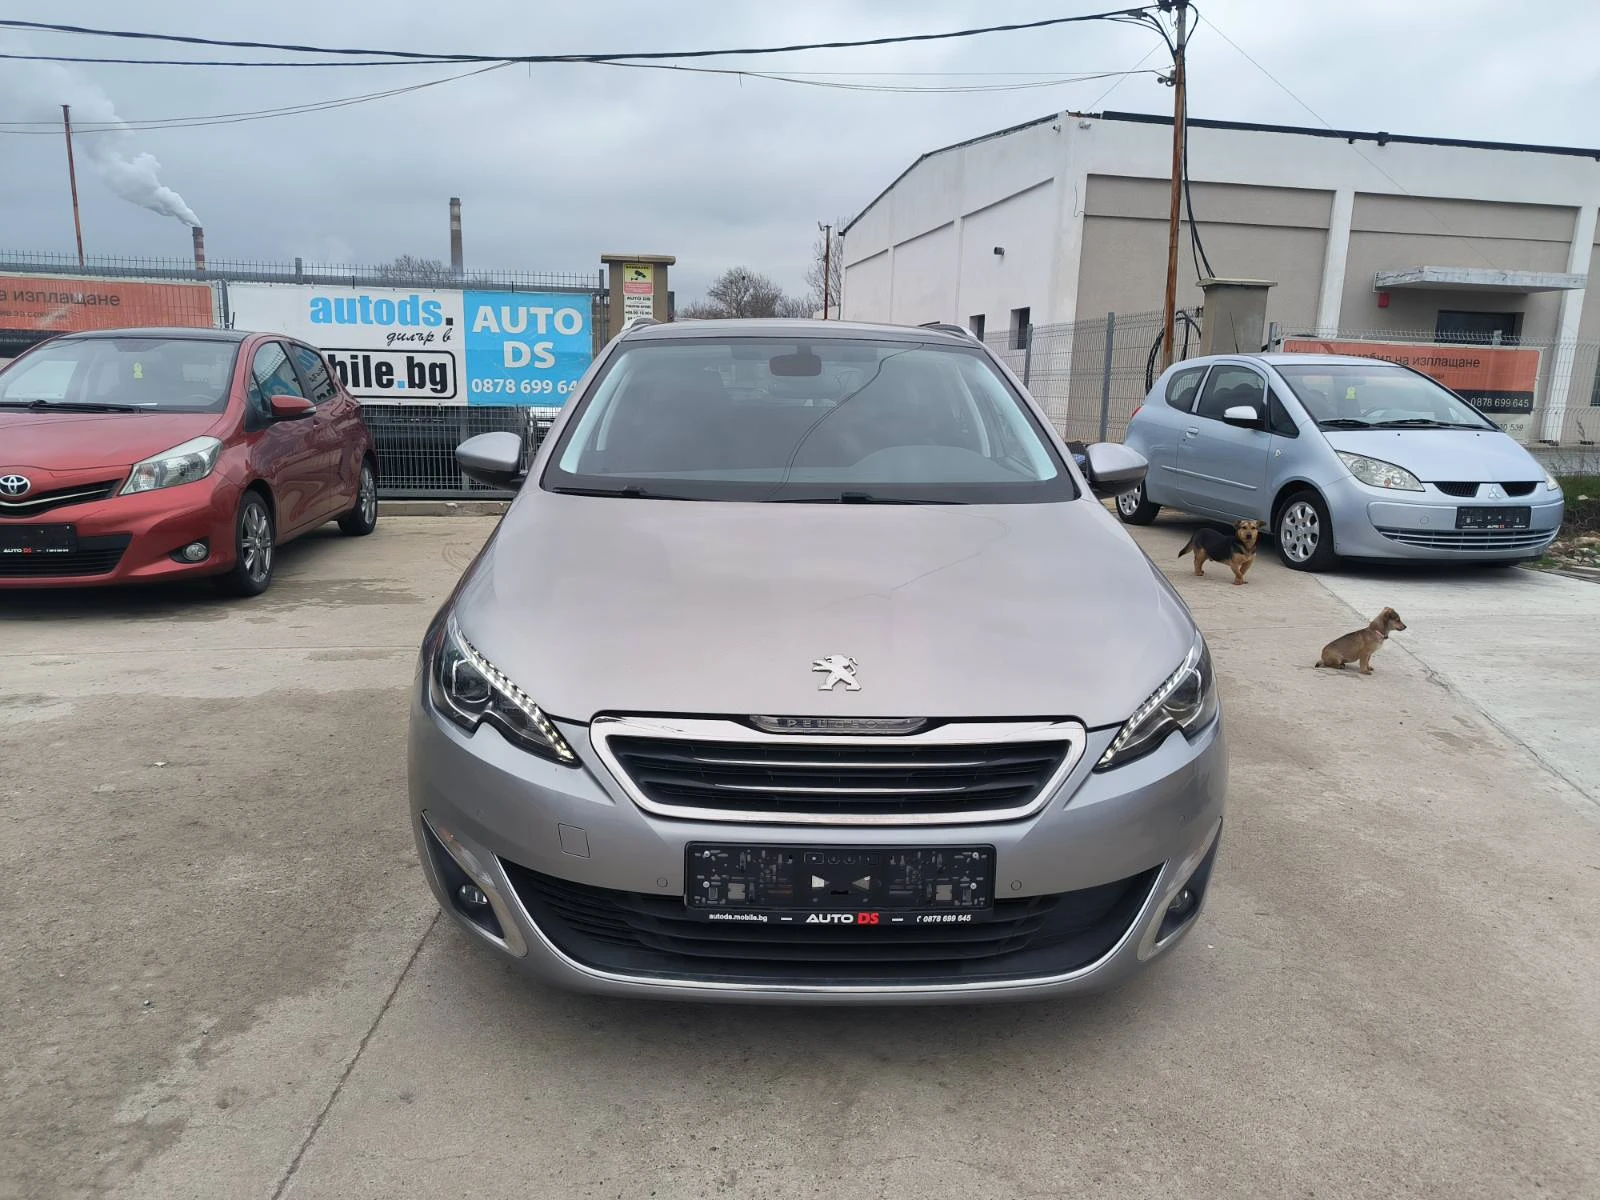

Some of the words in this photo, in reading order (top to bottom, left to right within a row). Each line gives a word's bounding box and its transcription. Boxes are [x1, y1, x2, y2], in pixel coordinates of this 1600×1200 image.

[13, 290, 120, 306] изплащане
[472, 305, 583, 335] AUTO
[503, 340, 556, 369] DS
[1412, 356, 1481, 368] изплащане
[327, 353, 448, 394] bile.bg
[471, 378, 516, 394] 0878
[520, 379, 553, 394] 699
[557, 380, 578, 394] 64
[1470, 397, 1493, 407] 0878
[1494, 398, 1511, 408] 699
[1512, 399, 1529, 408] 645
[806, 913, 854, 923] AUTO
[857, 912, 880, 924] DS
[923, 915, 941, 923] 0878
[942, 914, 956, 922] 699
[957, 914, 972, 922] 645
